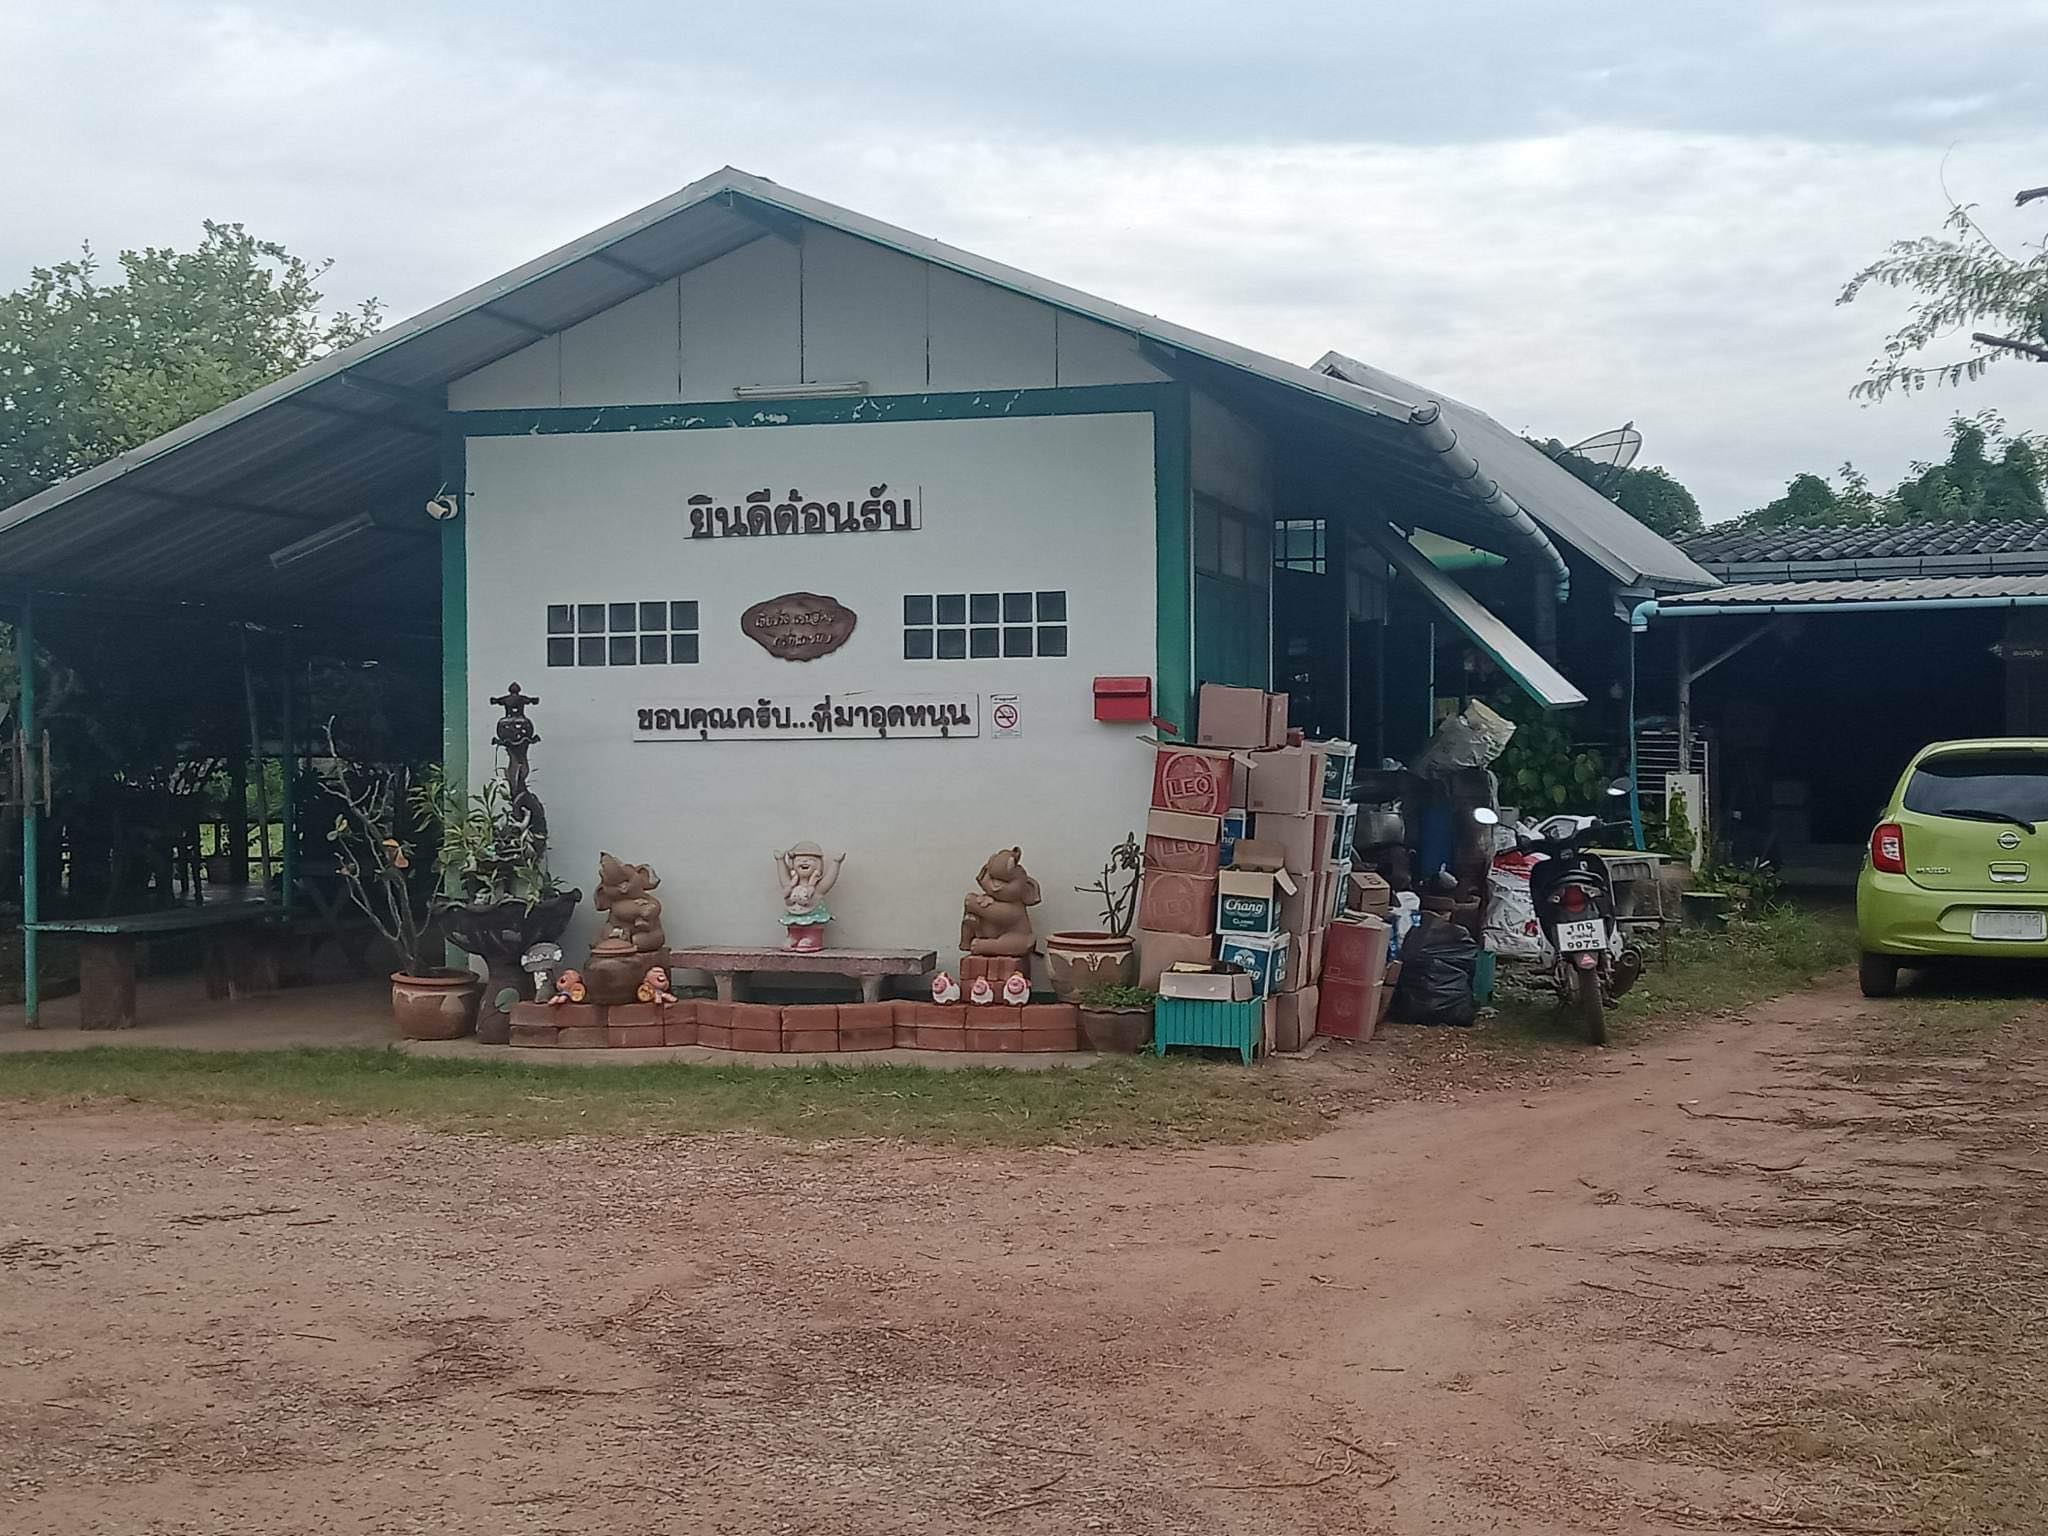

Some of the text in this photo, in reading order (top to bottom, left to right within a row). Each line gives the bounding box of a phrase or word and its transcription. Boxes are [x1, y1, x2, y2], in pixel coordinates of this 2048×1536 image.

[688, 483, 911, 538] ยินดีต้อนรับ
[1168, 776, 1211, 797] LEO
[1225, 898, 1264, 914] Chang
